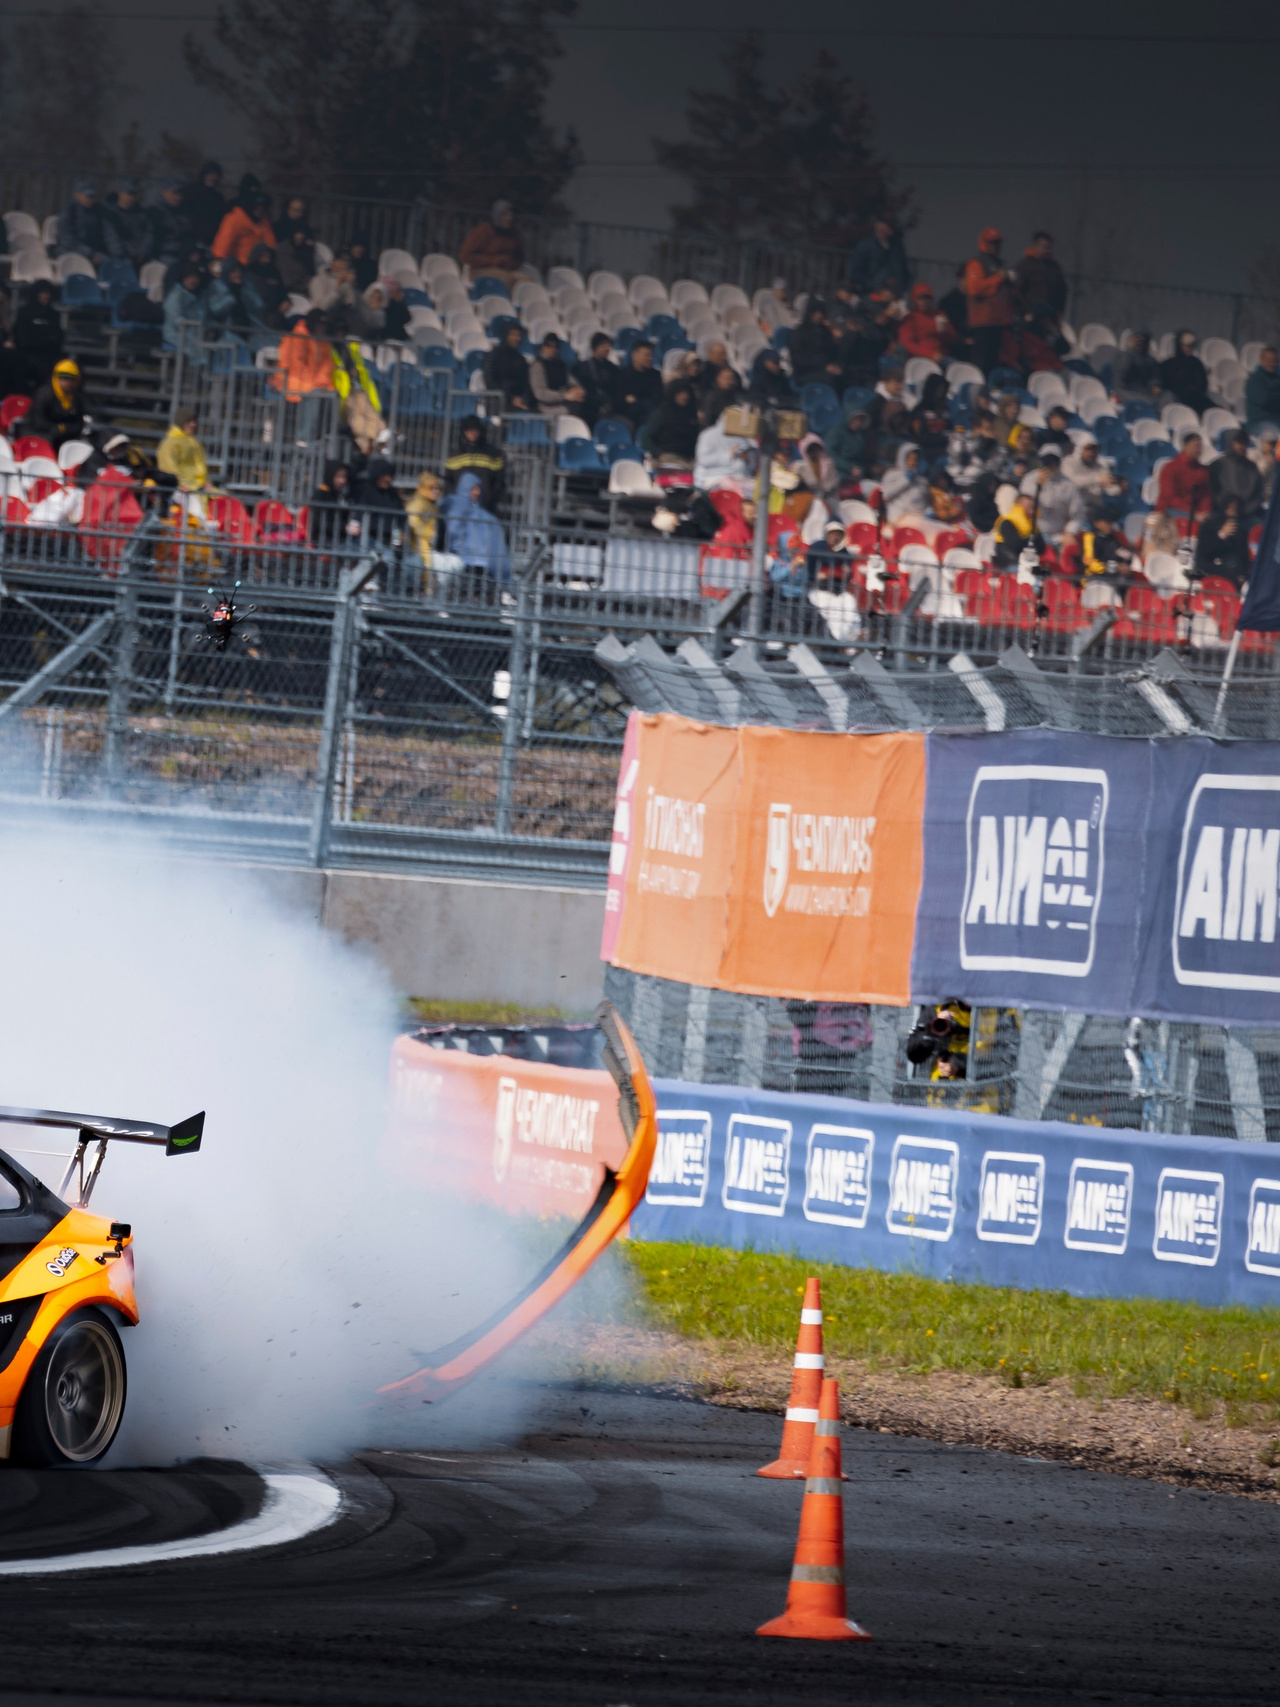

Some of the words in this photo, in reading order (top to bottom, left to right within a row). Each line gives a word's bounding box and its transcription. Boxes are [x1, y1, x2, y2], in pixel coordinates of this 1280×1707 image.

[966, 815, 1095, 931] AIMOL
[1179, 825, 1280, 943] AIM
[727, 1136, 786, 1195] AIMOL
[808, 1147, 868, 1206] AIMOL
[892, 1158, 953, 1219] AIMOL
[982, 1171, 1039, 1225] AIMOL
[1070, 1180, 1126, 1234] AIMOL
[1159, 1190, 1218, 1245] AIMOL
